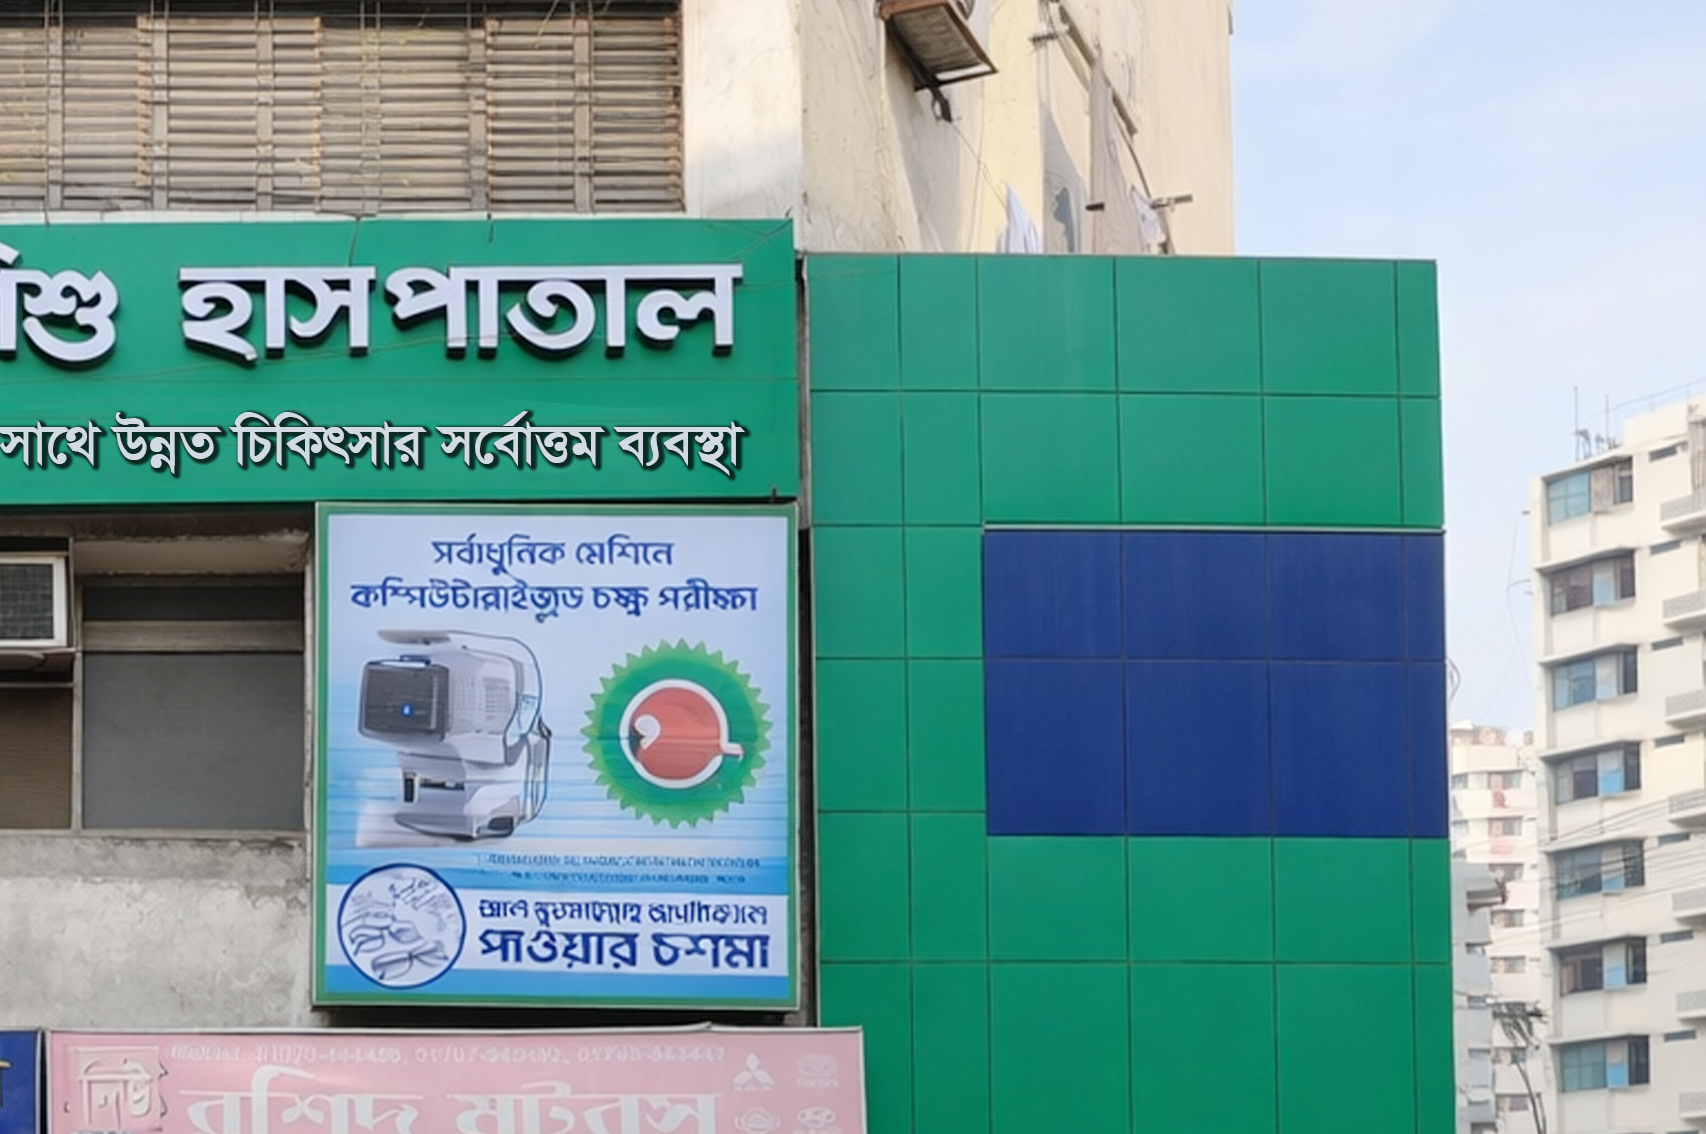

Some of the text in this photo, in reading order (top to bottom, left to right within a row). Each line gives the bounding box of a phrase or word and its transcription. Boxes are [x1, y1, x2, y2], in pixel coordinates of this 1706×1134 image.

[178, 263, 744, 364] হাসপাতাল
[110, 411, 222, 476] উন্নত
[229, 411, 427, 468] চিকিৎসার
[435, 410, 603, 468] সর্বোত্তম
[612, 420, 746, 477] ব্যবস্থা
[574, 533, 675, 566] মেশিনে
[478, 928, 770, 969] পাওয়ার চশমা
